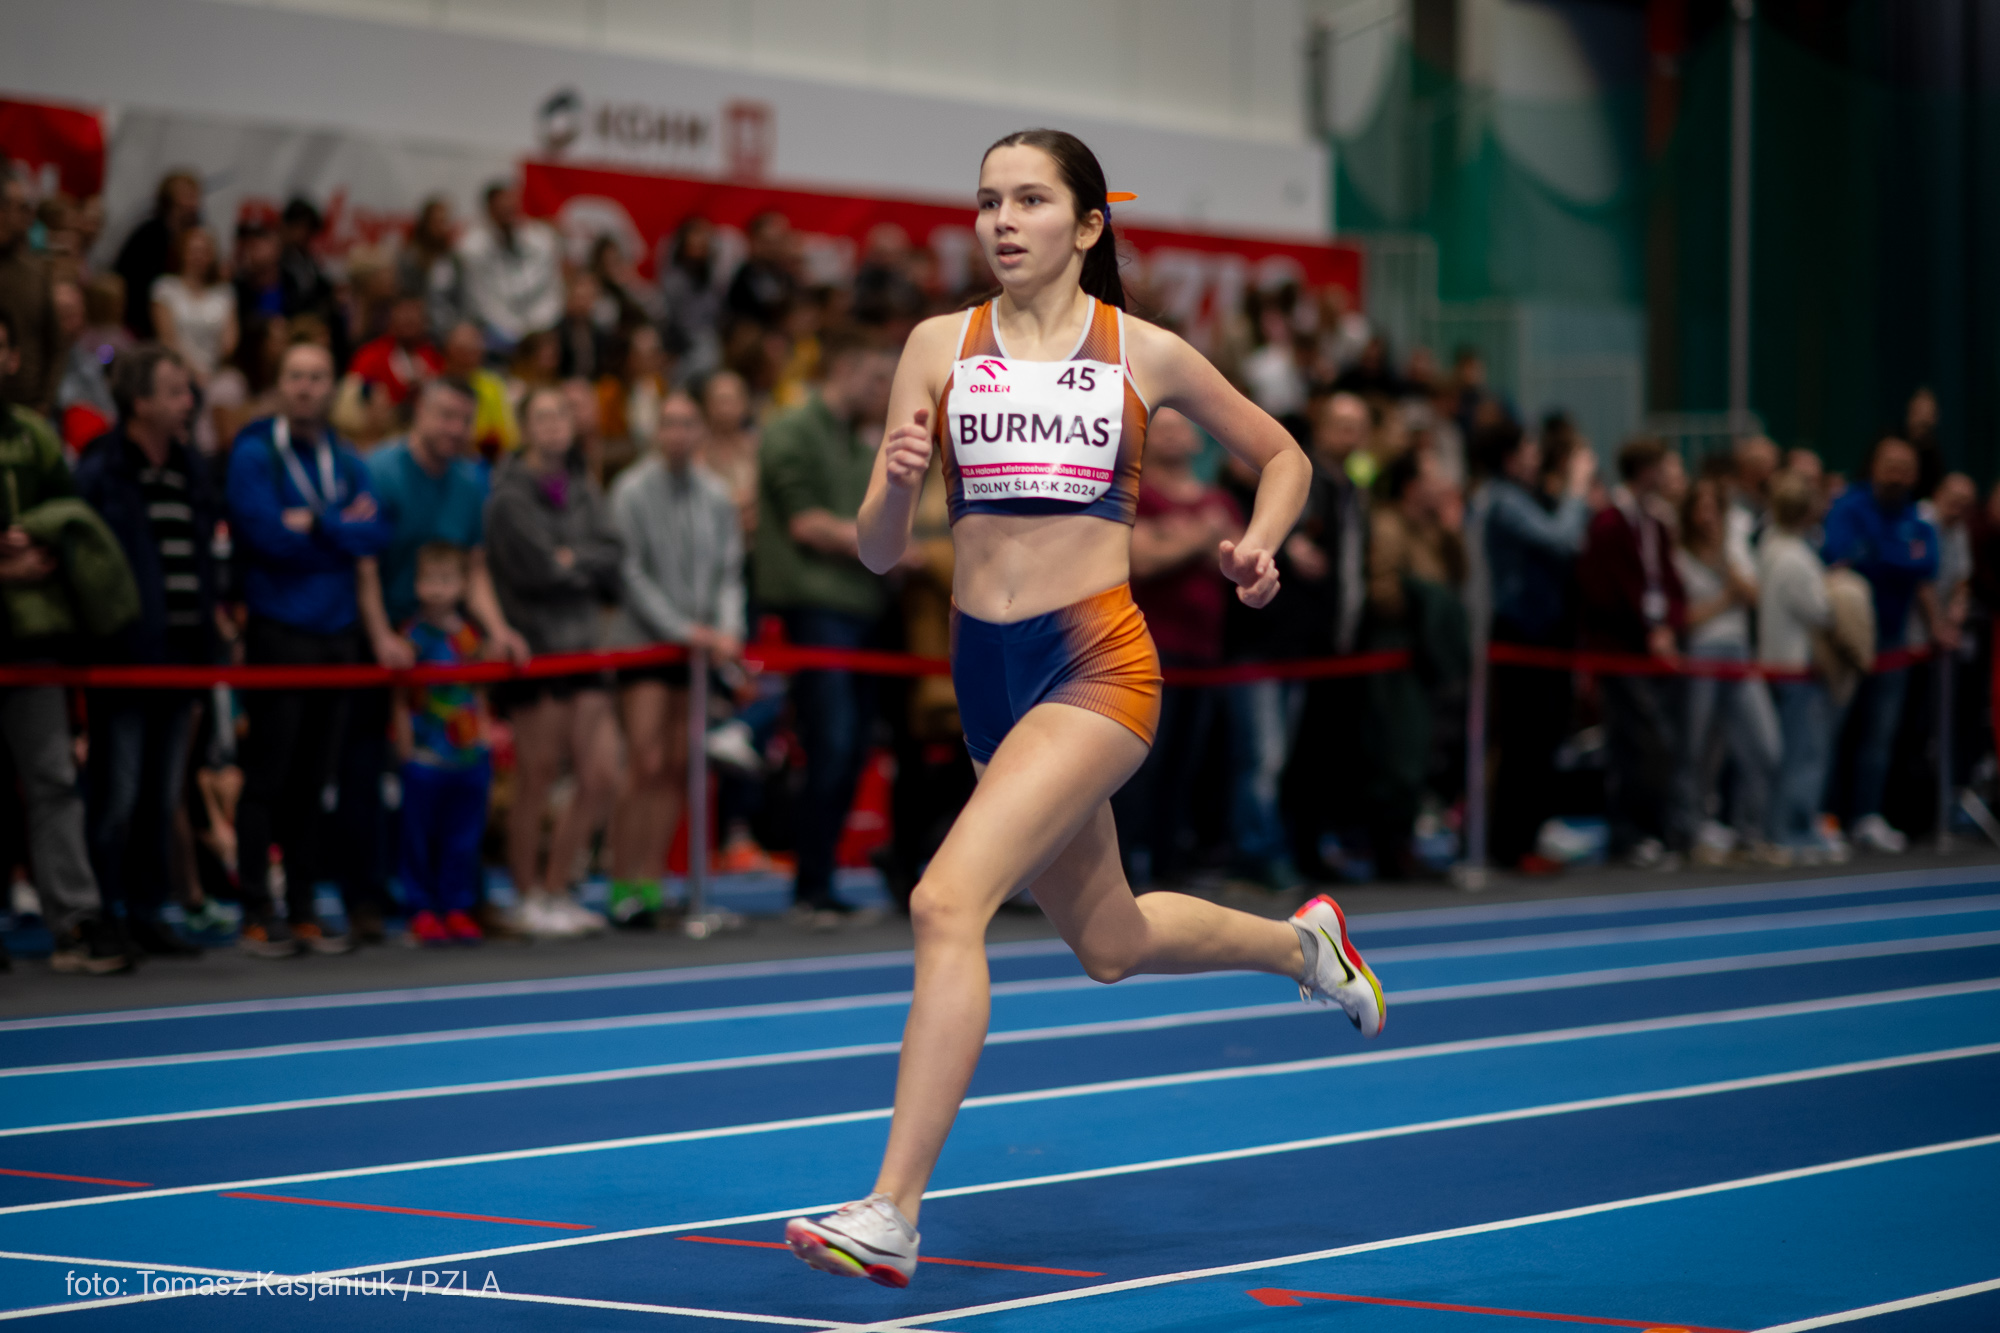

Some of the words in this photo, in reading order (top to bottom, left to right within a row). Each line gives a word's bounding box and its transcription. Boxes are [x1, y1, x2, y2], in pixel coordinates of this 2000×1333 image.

[969, 384, 1011, 393] ORLEN
[1057, 367, 1096, 392] 45
[959, 413, 1110, 447] BURMAS
[975, 467, 1001, 475] Halowe
[1002, 465, 1051, 473] Mistrzostwa
[1052, 465, 1076, 475] Polski
[1077, 468, 1091, 478] U18
[1096, 471, 1109, 480] U20
[972, 481, 1010, 494] DOLNY
[1014, 477, 1059, 493] ŚLĄSK
[1064, 482, 1096, 497] 2024
